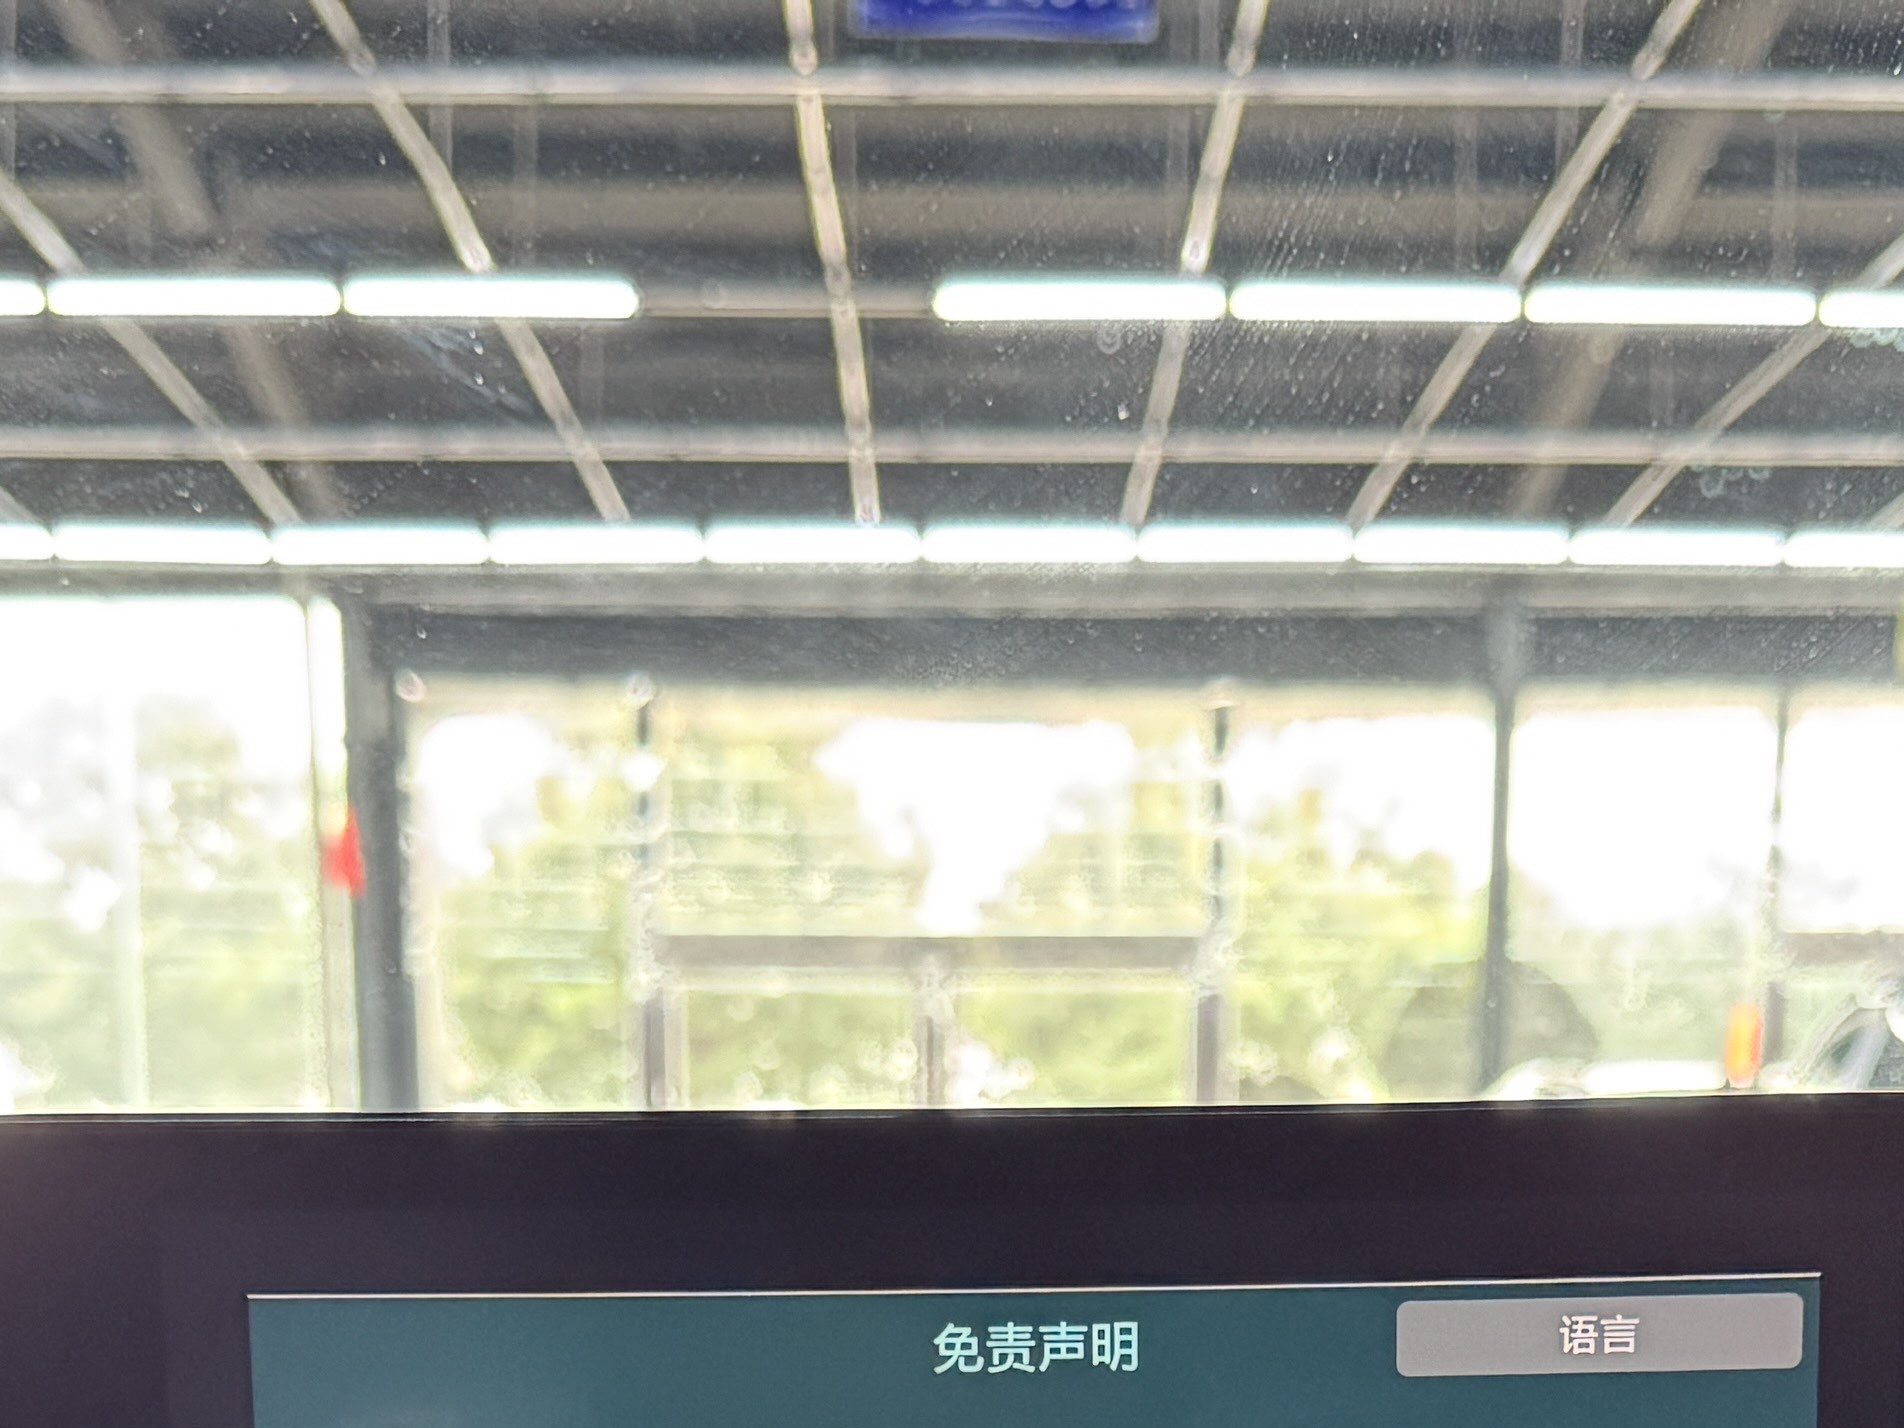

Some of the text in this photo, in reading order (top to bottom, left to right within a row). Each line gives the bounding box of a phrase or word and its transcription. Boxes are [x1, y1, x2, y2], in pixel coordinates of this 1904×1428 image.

[933, 1320, 1139, 1374] 免责声明
[1559, 1314, 1640, 1355] 语言
